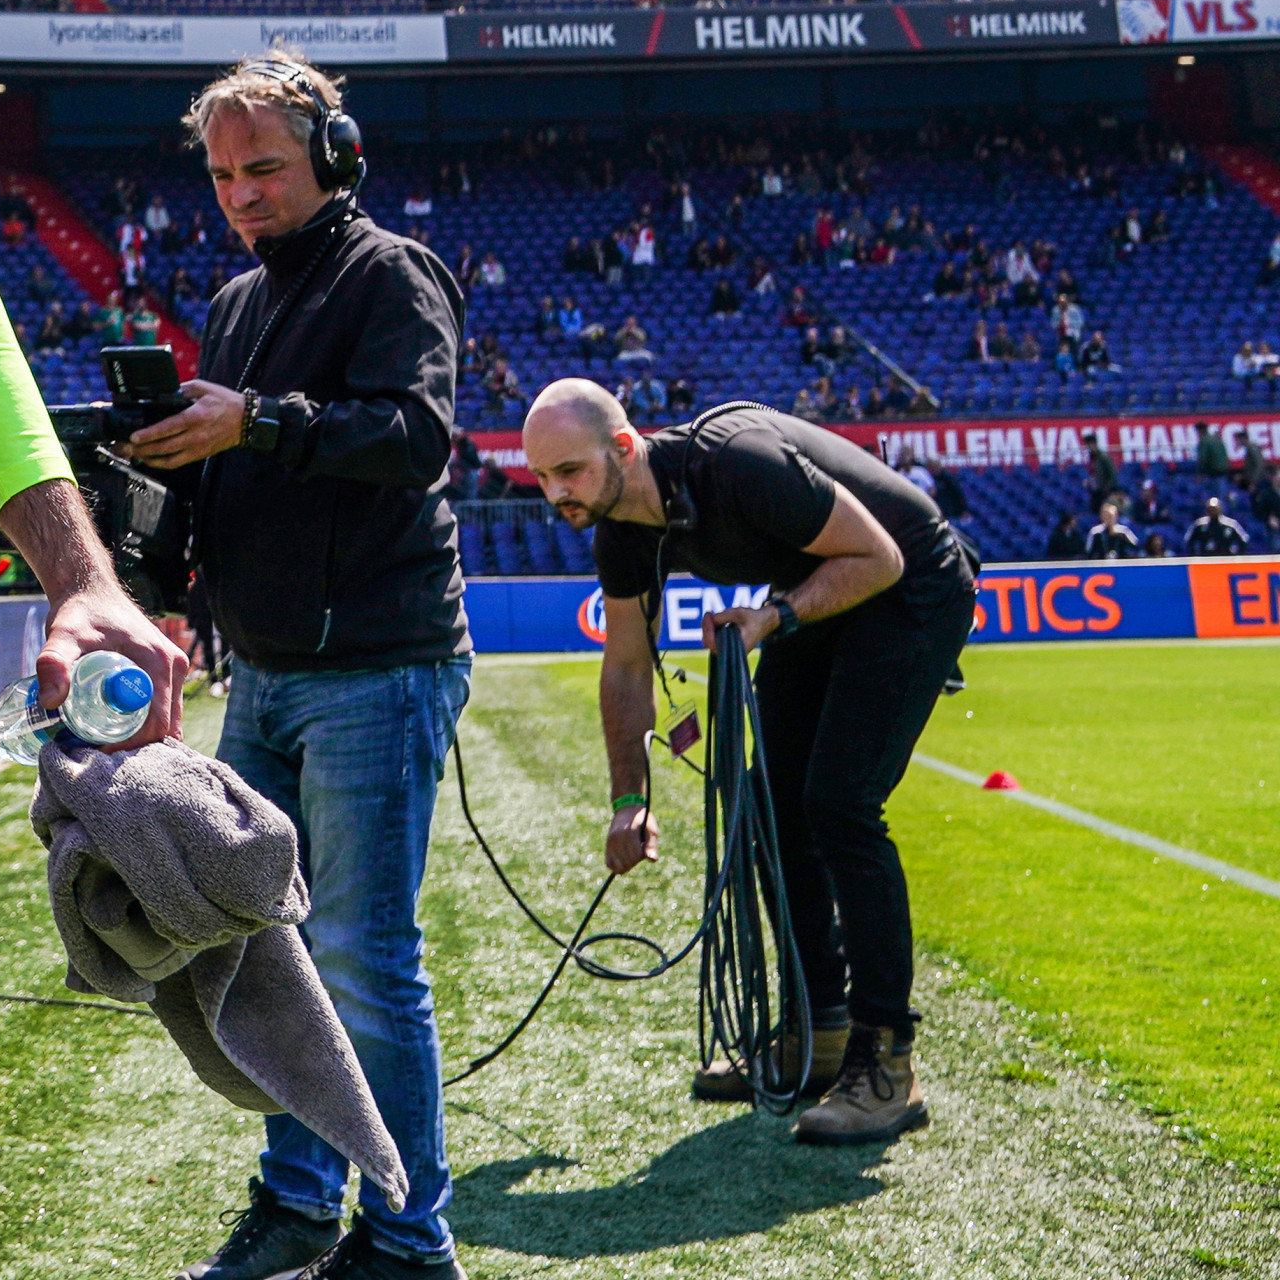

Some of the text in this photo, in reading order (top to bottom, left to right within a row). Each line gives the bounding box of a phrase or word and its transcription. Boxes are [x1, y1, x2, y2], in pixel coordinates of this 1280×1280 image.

[694, 13, 867, 50] HELMINK
[970, 11, 1086, 37] HELMINK
[1184, 0, 1258, 34] VLS
[502, 23, 616, 48] HELMINK
[877, 427, 1024, 467] WILLEM
[119, 675, 148, 698] SOURCY
